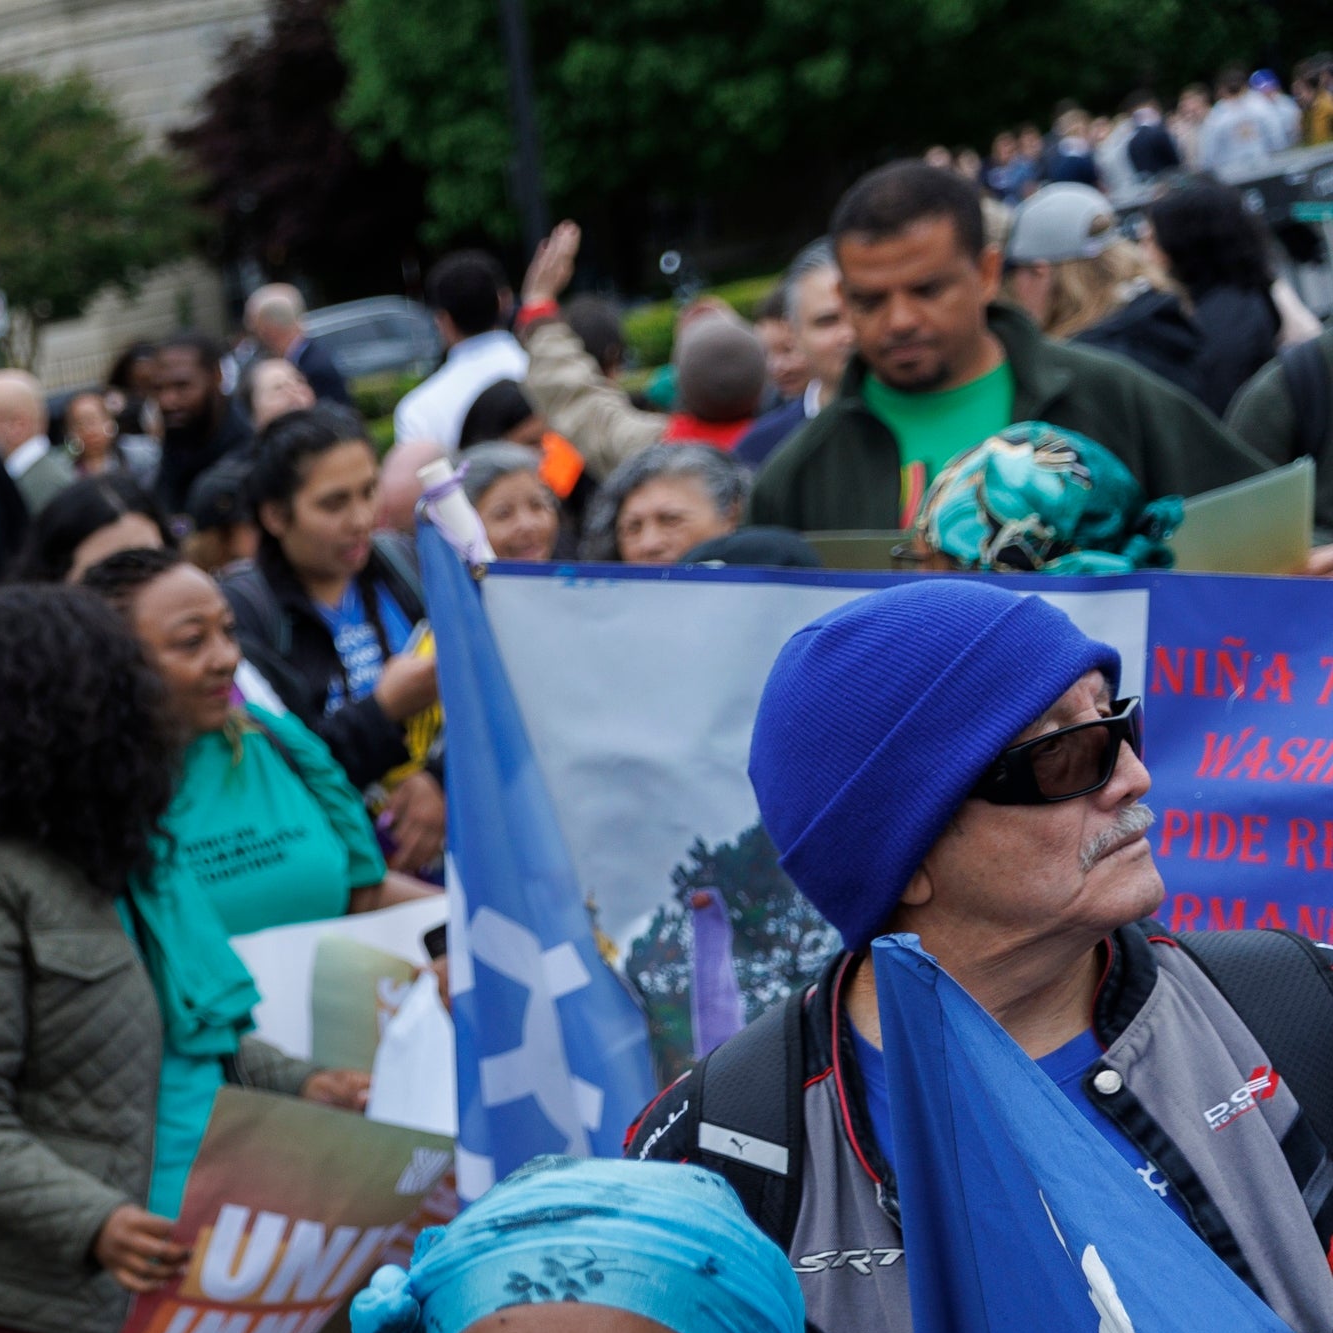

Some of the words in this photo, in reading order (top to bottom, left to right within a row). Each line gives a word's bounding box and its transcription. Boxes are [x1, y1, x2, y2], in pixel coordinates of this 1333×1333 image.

[1150, 636, 1296, 703] NIÑA
[1157, 809, 1269, 864] PIDE
[199, 1203, 389, 1304] UNI
[792, 1248, 904, 1275] SRT
